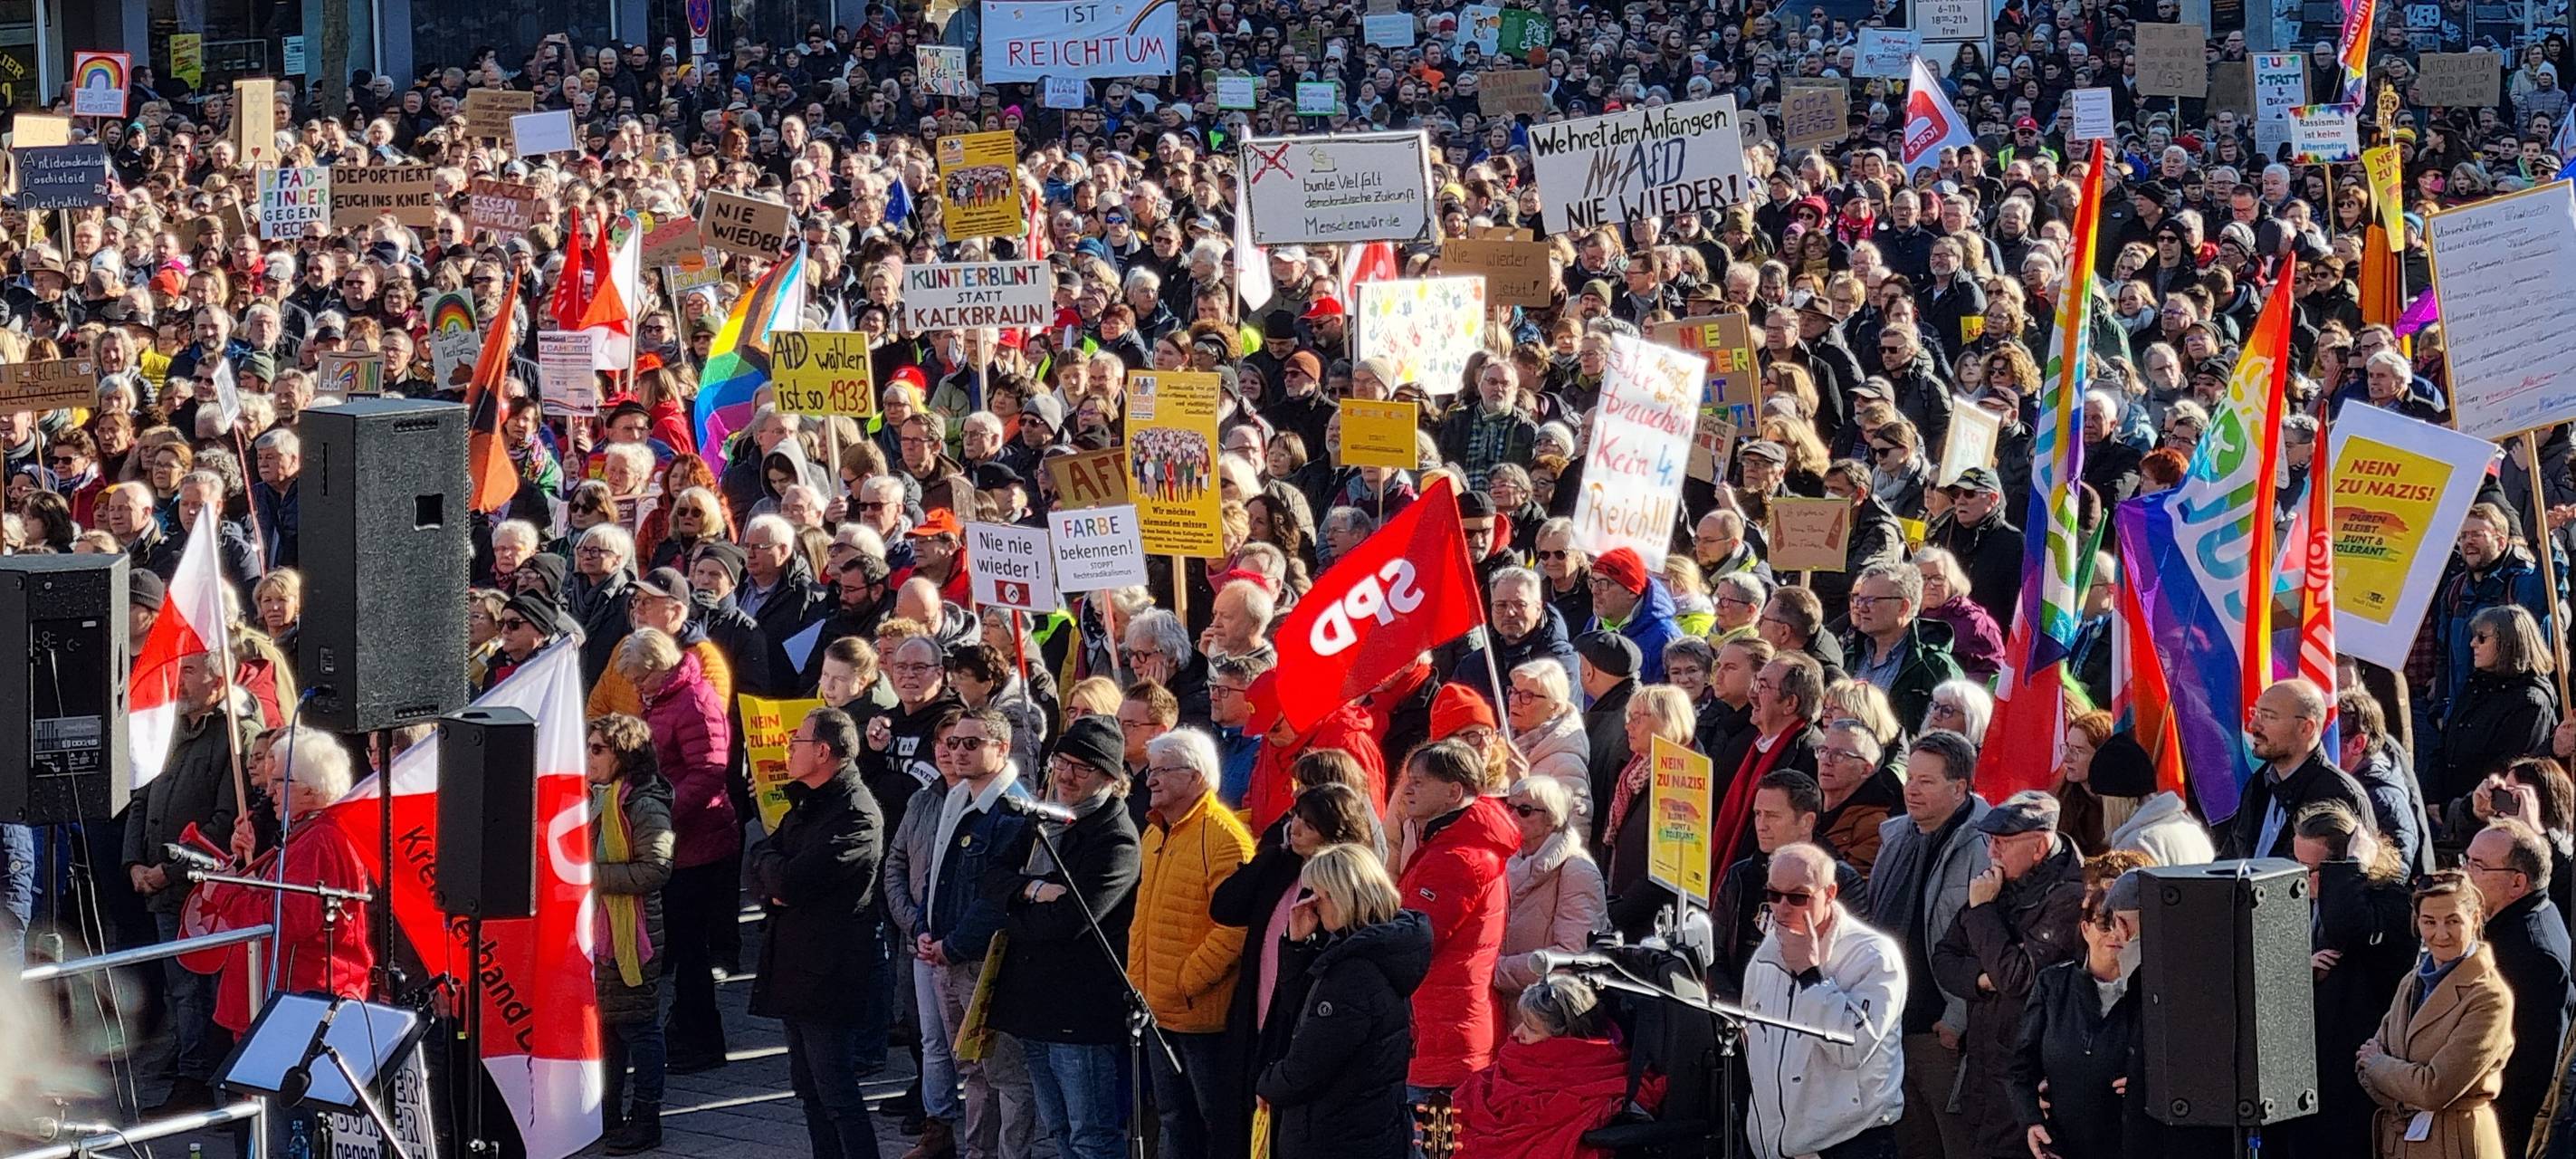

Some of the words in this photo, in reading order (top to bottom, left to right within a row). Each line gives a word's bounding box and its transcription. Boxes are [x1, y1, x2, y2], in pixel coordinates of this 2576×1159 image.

[1065, 5, 1098, 23] IST
[1942, 27, 1960, 35] frei
[1008, 37, 1167, 67] REICHTUM
[2258, 73, 2301, 86] STATT
[1531, 120, 1608, 157] Wehret
[1610, 122, 1640, 146] den
[1641, 107, 1728, 140] Anfängen
[2299, 118, 2345, 128] Rassismus
[2304, 130, 2315, 139] ist
[2316, 129, 2342, 139] keine
[2301, 142, 2348, 150] Alternative
[265, 168, 323, 189] PFAD-
[336, 167, 434, 185] DEPORTIERT
[2376, 169, 2392, 182] ZU
[263, 187, 327, 207] FINDER
[335, 194, 368, 209] EUCH
[372, 194, 392, 207] INS
[396, 193, 432, 207] KNIE
[472, 194, 518, 214] ESSEN
[263, 206, 321, 222] GEGEN
[715, 202, 756, 224] NIE
[1565, 197, 1609, 231] NIE
[711, 221, 783, 256] WIEDER
[1445, 243, 1470, 263] Nie
[1485, 246, 1529, 267] wieder
[911, 265, 1040, 291] KUNTERBUNT
[957, 291, 1003, 303] STATT
[913, 304, 1044, 328] KACKBRAUN
[1679, 323, 1721, 349] NIE
[772, 331, 808, 370] AfD
[815, 337, 866, 373] wählen
[778, 379, 804, 411] ist
[806, 390, 824, 410] so
[828, 379, 868, 414] 1933
[1595, 421, 1649, 475] Kein
[2350, 459, 2402, 478] NEIN
[2334, 478, 2363, 493] ZU
[2364, 481, 2437, 502] NAZIS!
[1166, 508, 1197, 516] möchten
[1064, 515, 1121, 539] FARBE
[1143, 518, 1181, 527] niemanden
[2342, 523, 2380, 535] BLEIBT
[979, 532, 1004, 551] Nie
[1007, 536, 1033, 555] nie
[2343, 534, 2374, 545] BUNT
[2375, 537, 2384, 546] &
[1059, 539, 1134, 560] bekennen!
[2333, 543, 2387, 556] TOLERANT
[977, 557, 1029, 579] wieder
[1090, 561, 1114, 570] STOPPT
[749, 714, 780, 729] NEIN
[749, 734, 764, 748] ZU
[1660, 756, 1684, 771] NEIN
[1656, 774, 1670, 786] ZU
[1672, 775, 1706, 790] NAZIS!
